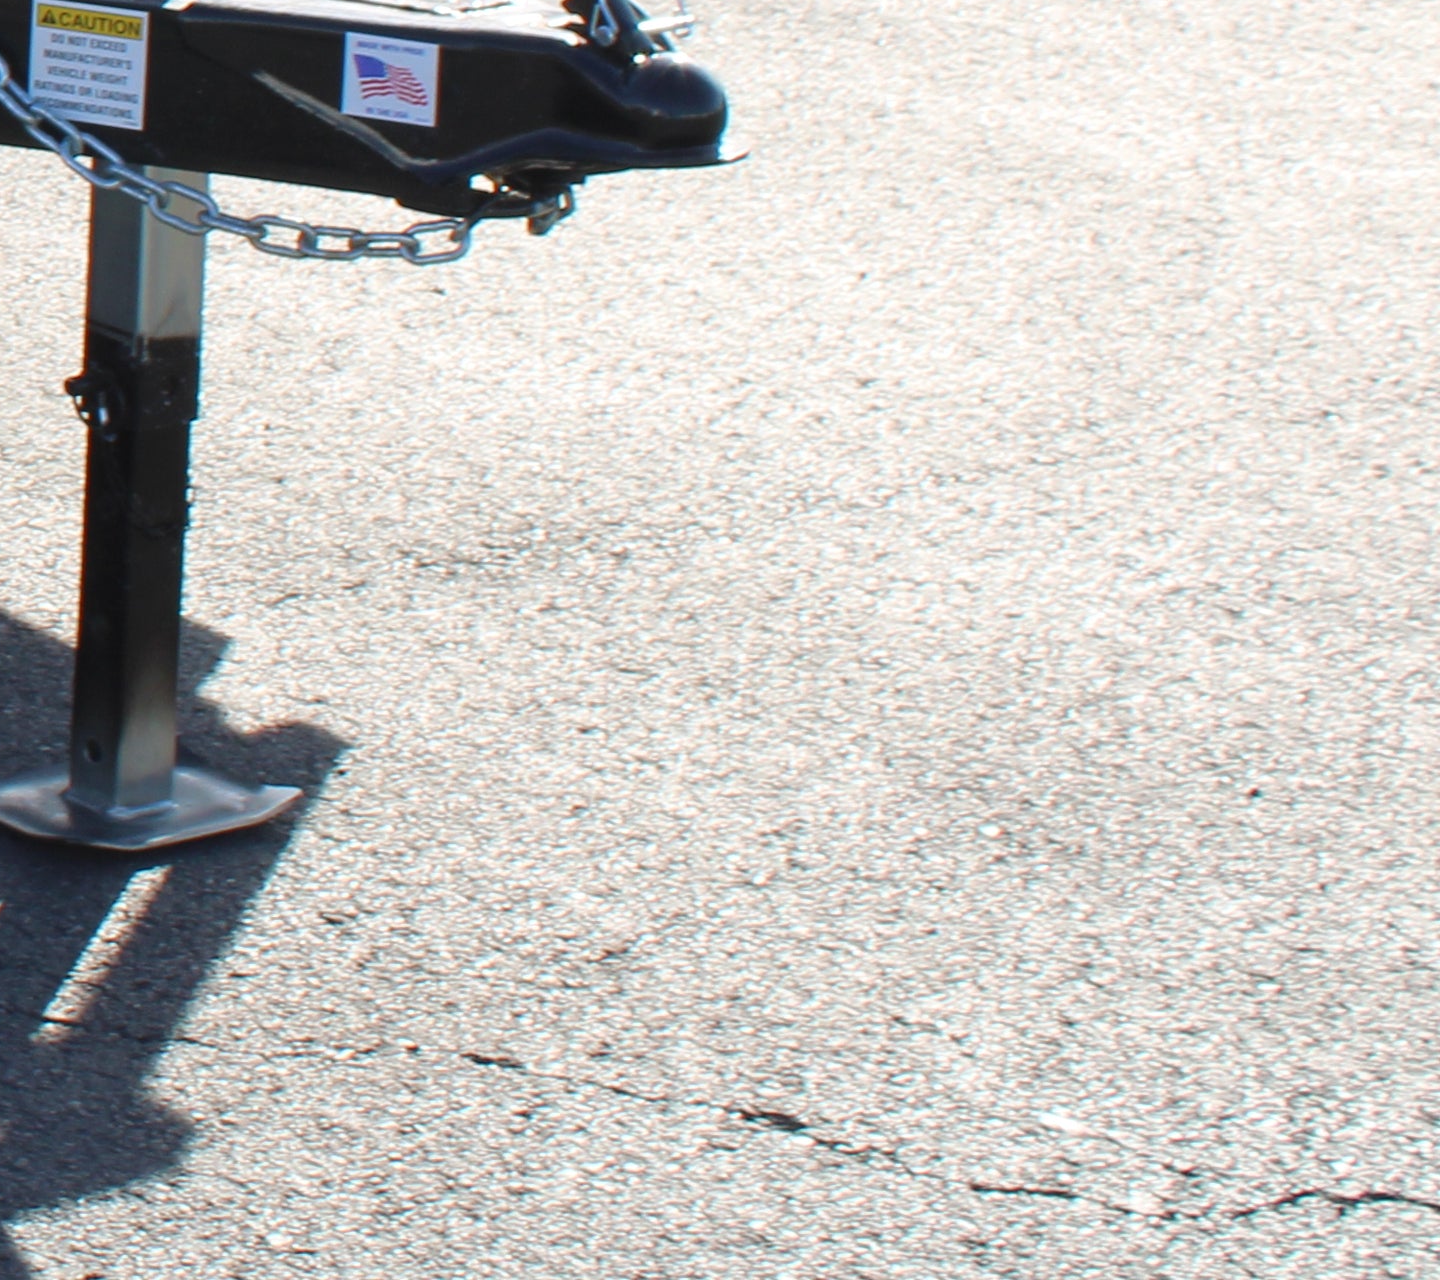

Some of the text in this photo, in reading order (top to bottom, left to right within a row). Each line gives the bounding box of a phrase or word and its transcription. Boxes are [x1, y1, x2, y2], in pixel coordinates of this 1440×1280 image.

[59, 11, 140, 36] CAUTION
[50, 33, 127, 53] DO NOT EXCEED
[47, 65, 127, 85] VEHICLE WEIGHT
[34, 80, 75, 94] RATINGS
[95, 89, 139, 104] LOADING
